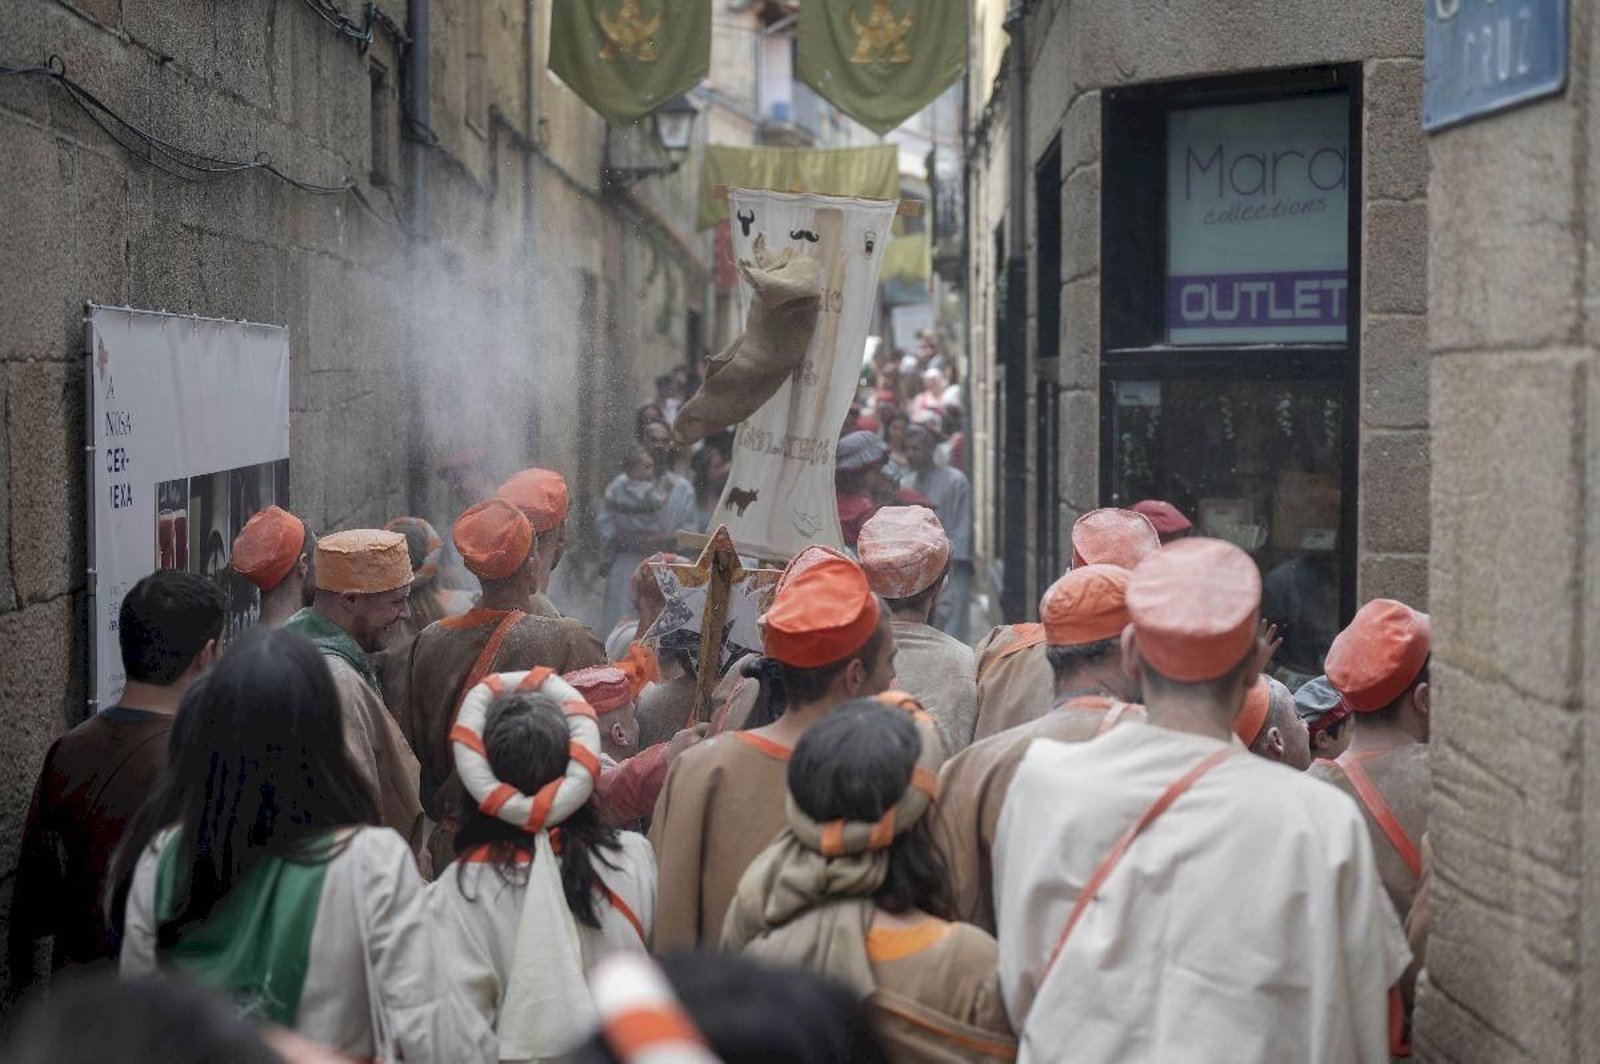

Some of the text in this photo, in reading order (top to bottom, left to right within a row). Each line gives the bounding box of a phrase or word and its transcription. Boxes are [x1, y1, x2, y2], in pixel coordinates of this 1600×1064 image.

[1185, 144, 1347, 200] Mara
[1203, 196, 1328, 226] collections
[1180, 278, 1348, 321] OUTLET
